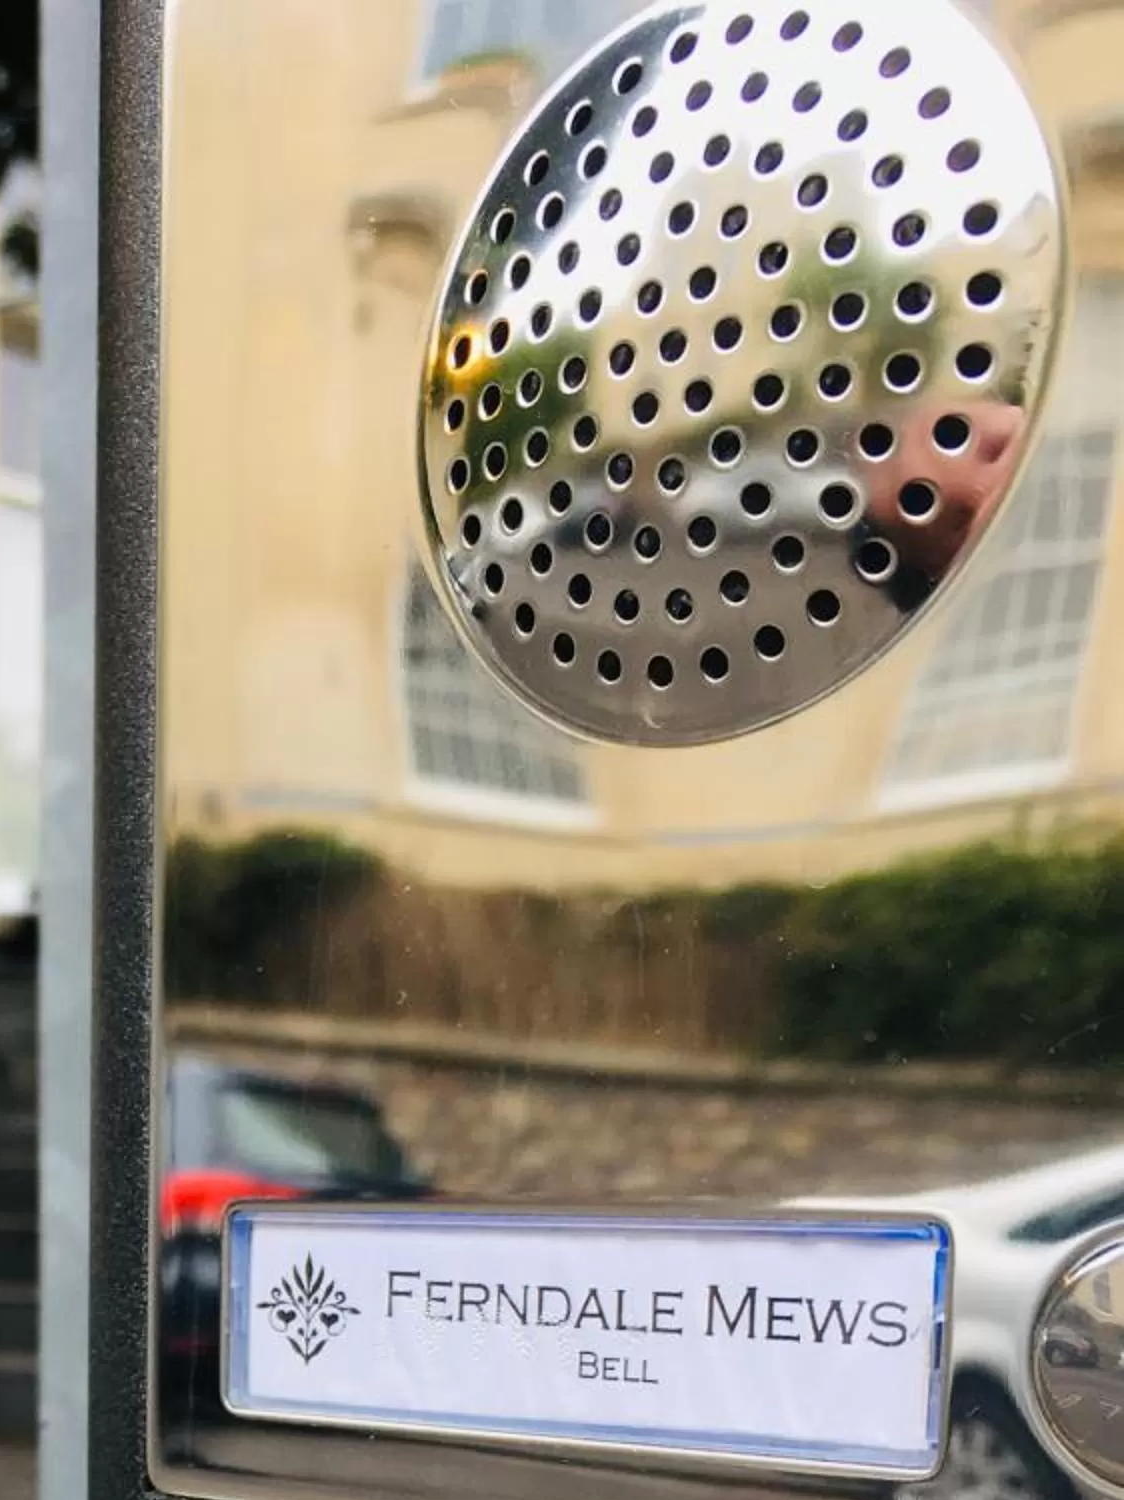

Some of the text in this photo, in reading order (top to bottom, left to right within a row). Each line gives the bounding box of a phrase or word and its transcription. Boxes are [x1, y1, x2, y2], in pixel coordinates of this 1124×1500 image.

[385, 1270, 909, 1348] FERNDALE MEWS
[577, 1350, 659, 1386] BELL
